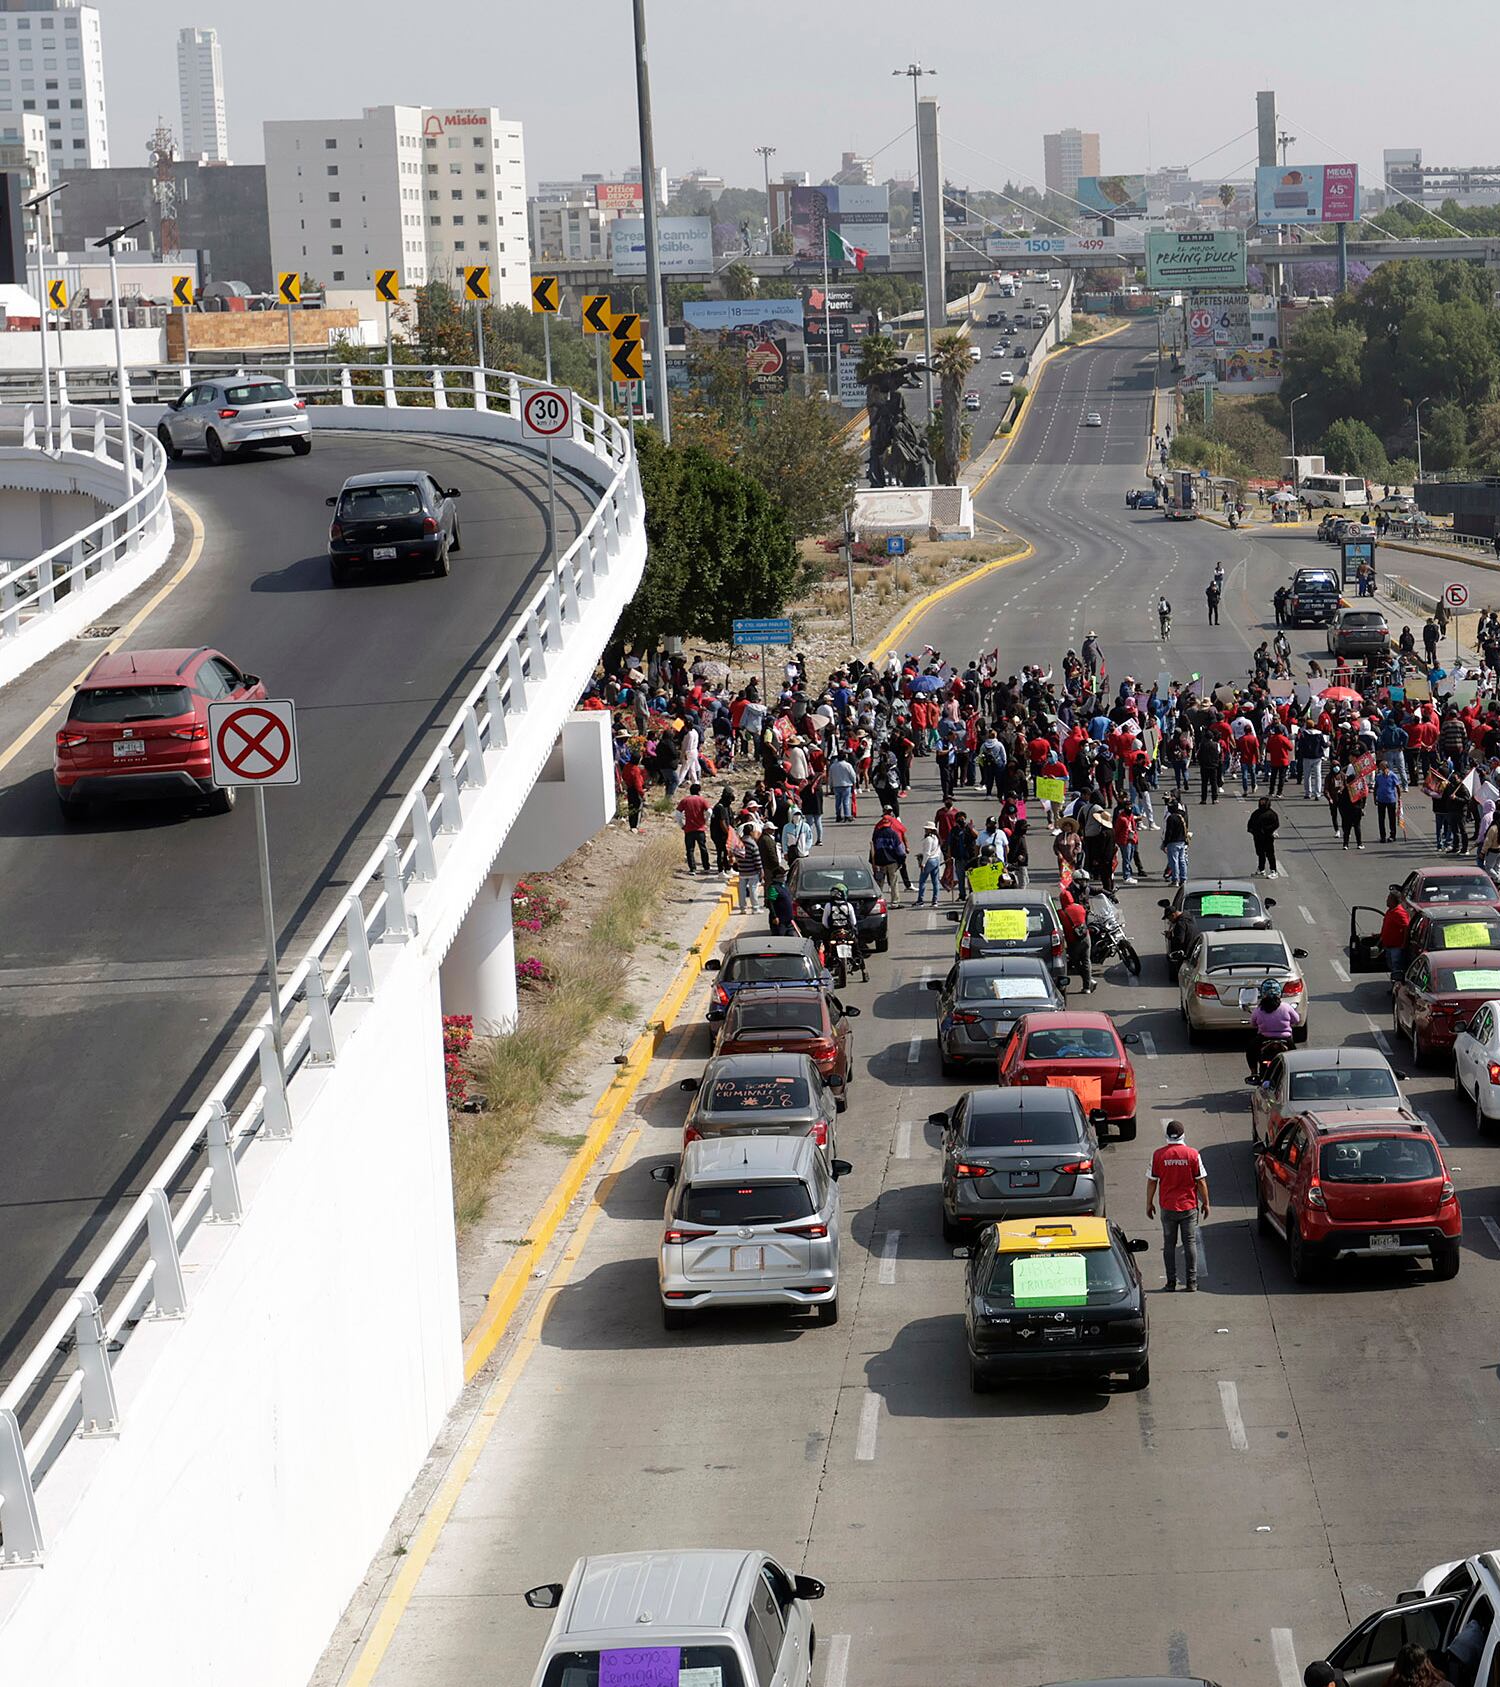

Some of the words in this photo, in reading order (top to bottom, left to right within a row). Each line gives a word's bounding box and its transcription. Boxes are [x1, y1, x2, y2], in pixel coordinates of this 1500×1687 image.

[444, 114, 488, 126] Misión
[606, 185, 635, 193] Office
[607, 192, 635, 200] DEPOT
[606, 200, 626, 209] petco
[663, 228, 709, 241] cambio
[1024, 239, 1051, 252] 150
[1077, 239, 1105, 250] $499
[1156, 252, 1202, 265] PEKING
[1204, 251, 1238, 262] DUCK
[1190, 297, 1222, 305] TAPETES
[1223, 295, 1249, 304] HAMID
[731, 307, 742, 317] 18
[1190, 313, 1212, 329] 60
[535, 399, 559, 419] 30
[715, 1081, 736, 1090] NO
